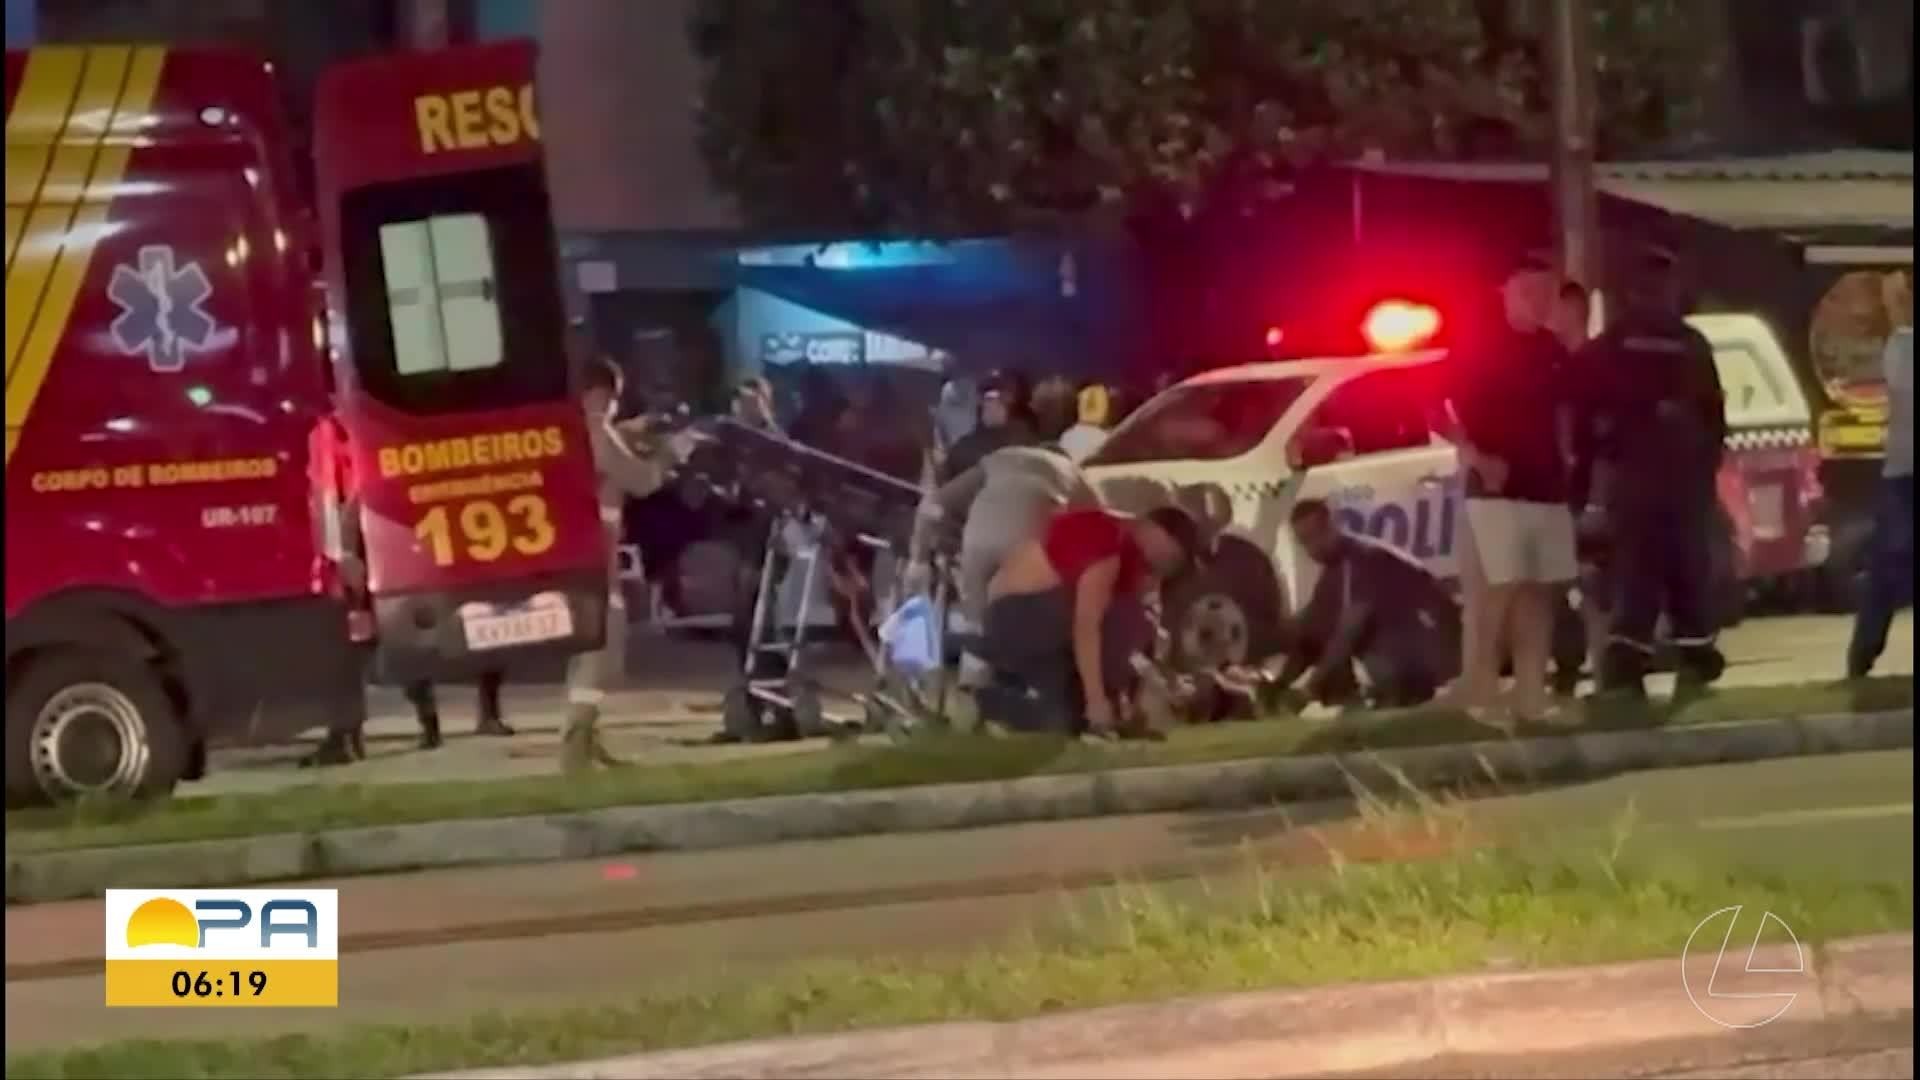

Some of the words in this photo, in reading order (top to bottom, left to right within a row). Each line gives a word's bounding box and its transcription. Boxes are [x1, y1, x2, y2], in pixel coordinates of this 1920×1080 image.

[32, 467, 109, 492] CORPO
[113, 464, 143, 488] DE
[149, 456, 277, 485] BOMBEIROS
[378, 426, 564, 478] BOMBEIROS
[415, 494, 556, 566] 193
